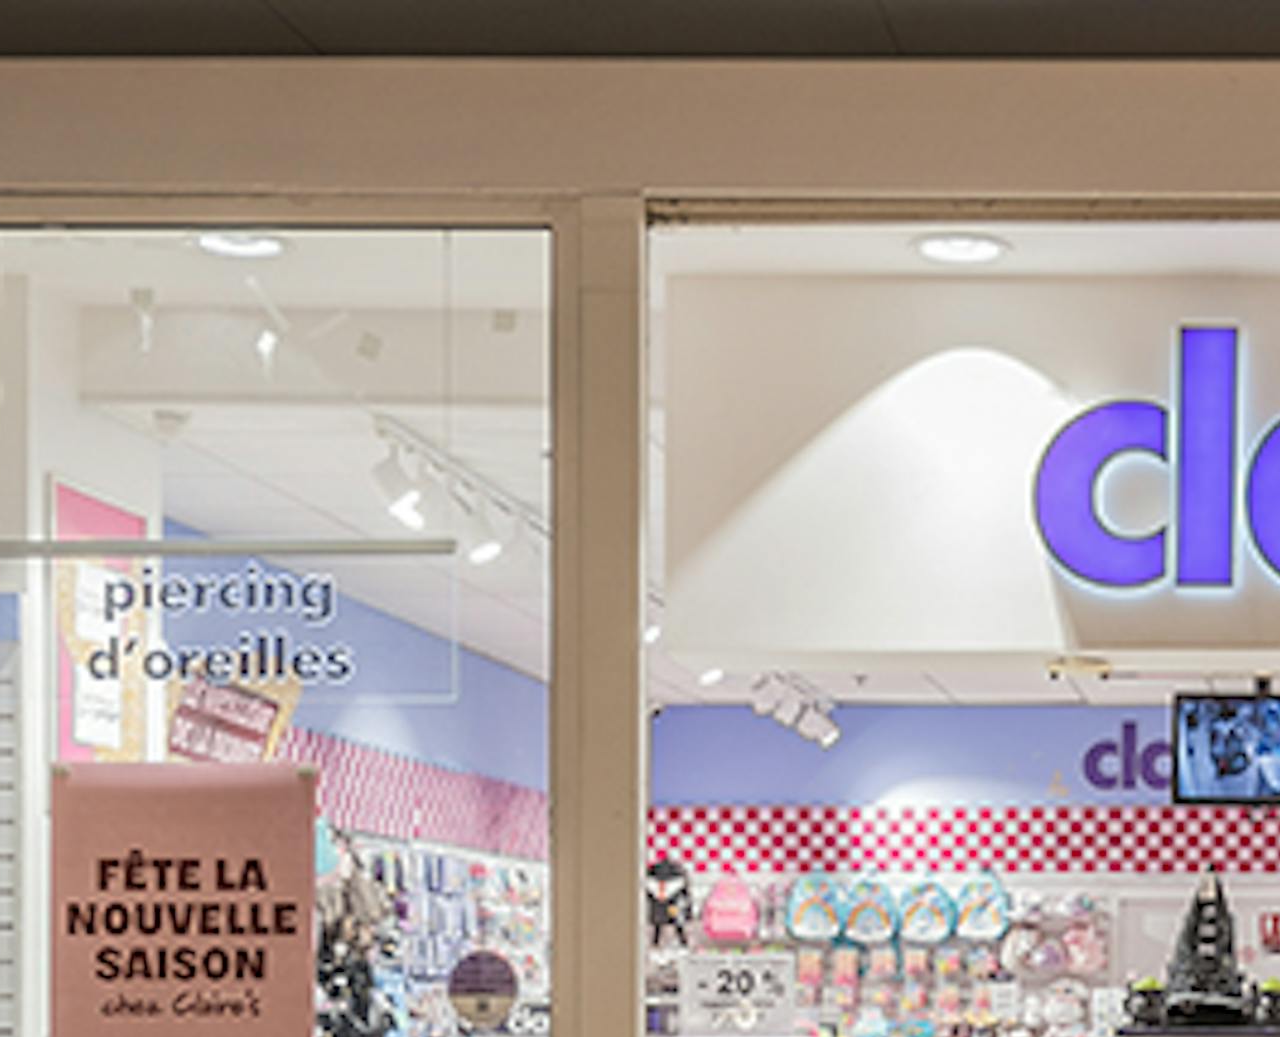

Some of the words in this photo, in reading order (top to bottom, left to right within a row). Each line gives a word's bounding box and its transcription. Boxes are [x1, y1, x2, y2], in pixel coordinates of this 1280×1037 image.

[104, 566, 333, 622] piercing
[88, 635, 351, 680] d'oreilles
[97, 850, 201, 891] FÊTE
[217, 859, 267, 891] LA
[67, 904, 297, 935] NOUVELLE
[95, 947, 265, 980] SAISON
